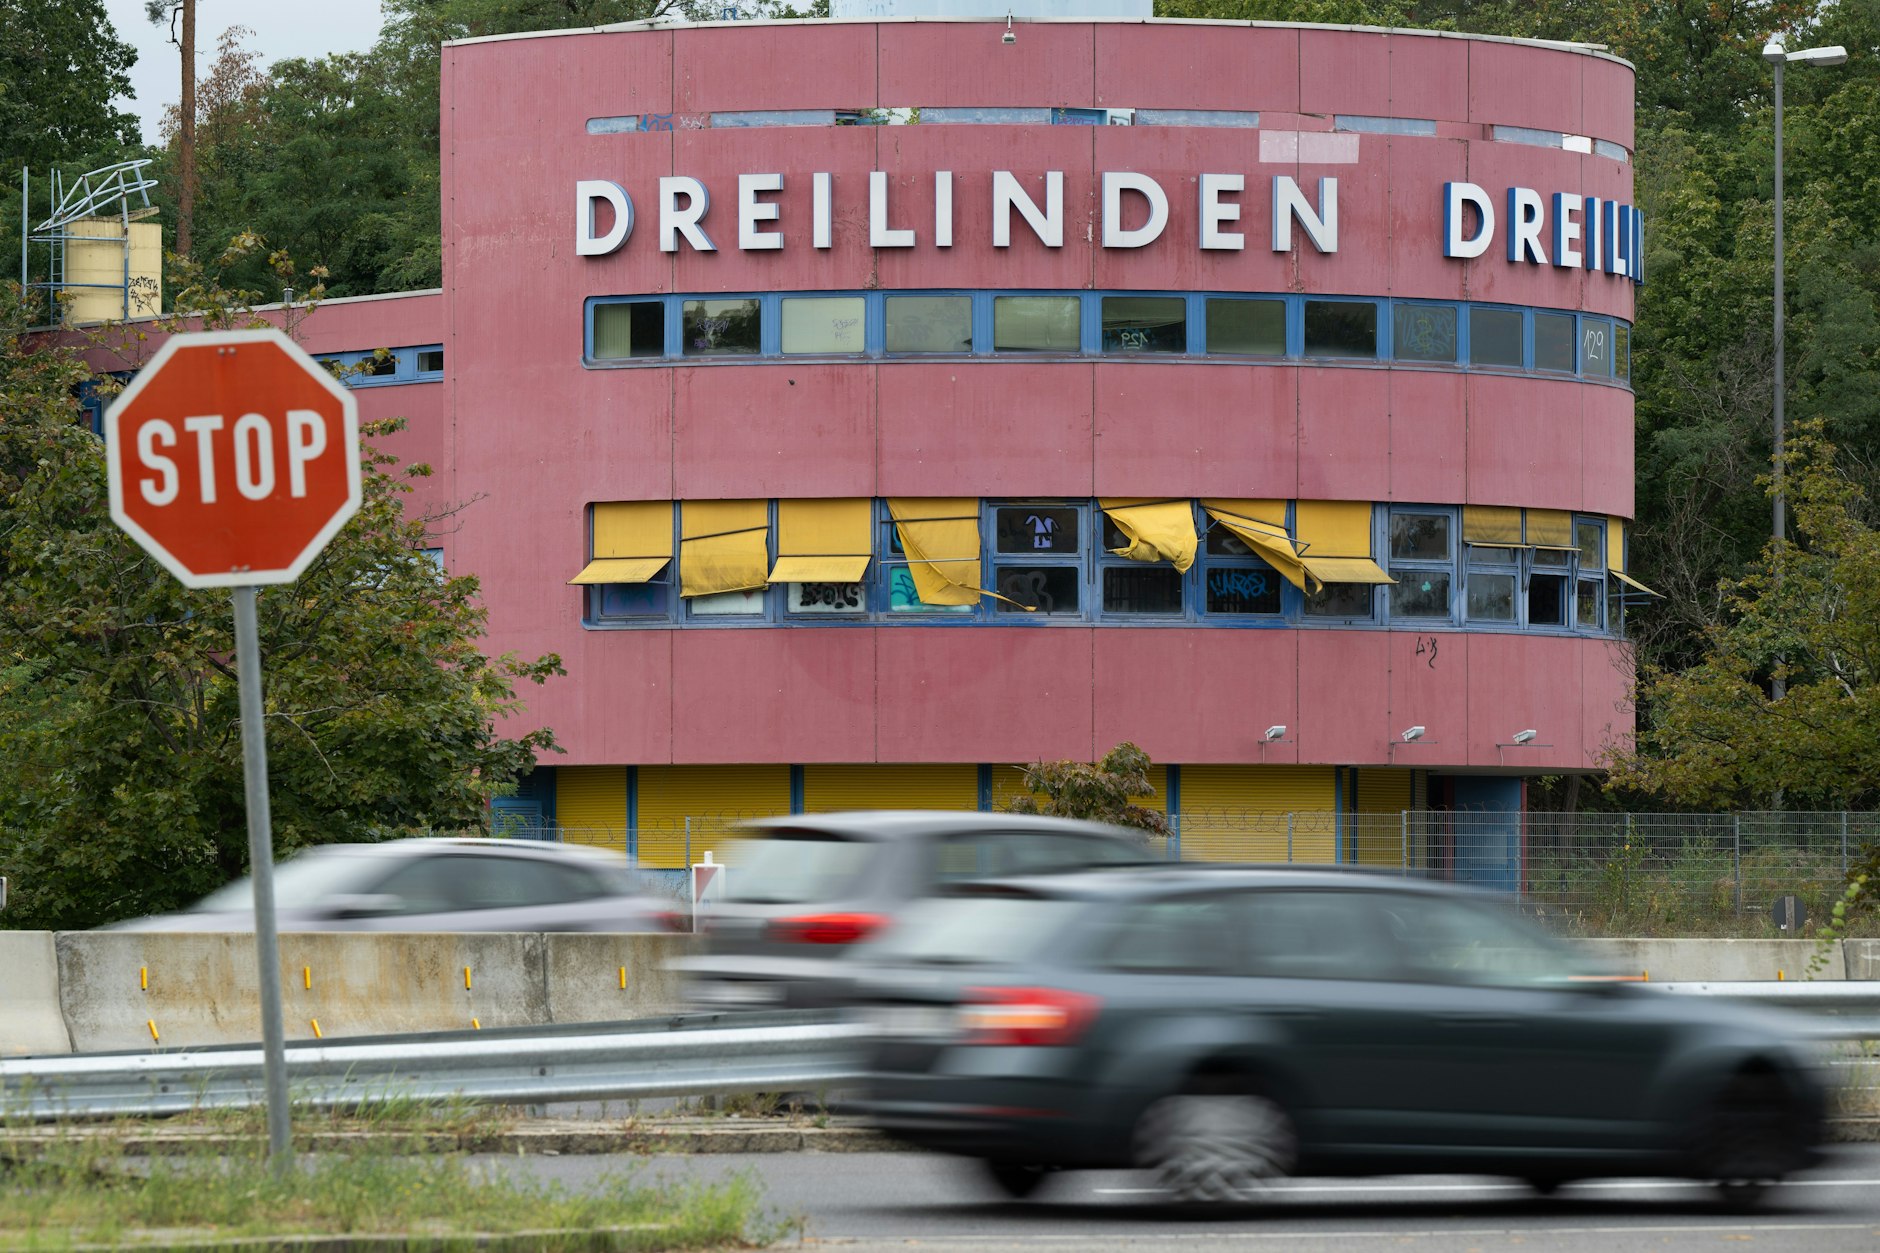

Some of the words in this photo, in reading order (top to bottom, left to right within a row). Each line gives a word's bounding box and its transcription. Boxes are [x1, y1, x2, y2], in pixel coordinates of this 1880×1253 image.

[576, 170, 1338, 256] DREILINDEN
[1583, 329, 1604, 361] 129
[137, 409, 328, 507] STOP
